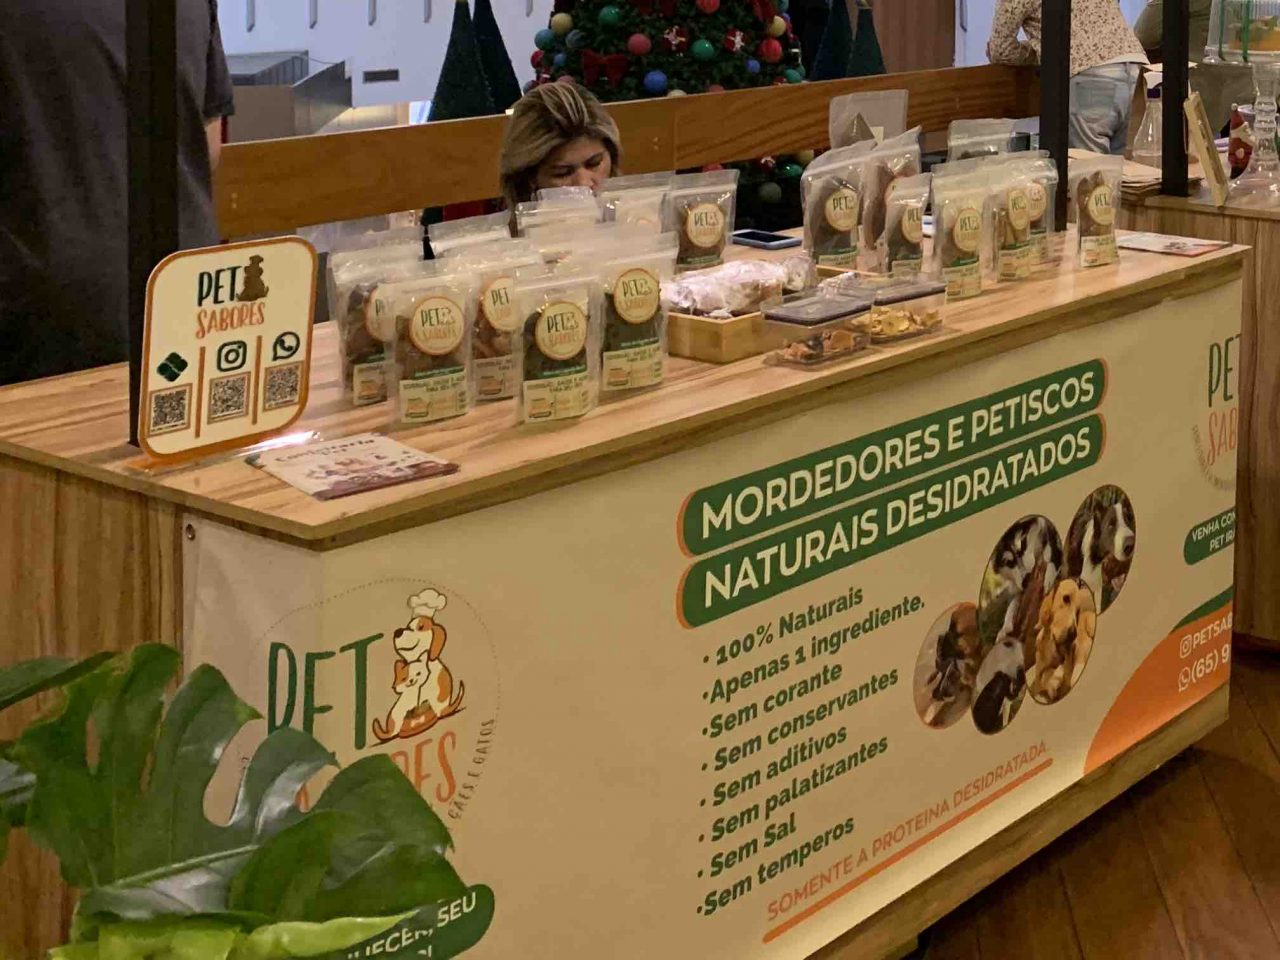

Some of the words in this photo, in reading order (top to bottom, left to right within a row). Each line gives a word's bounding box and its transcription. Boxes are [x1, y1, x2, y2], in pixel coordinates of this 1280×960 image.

[197, 265, 242, 307] PET
[420, 307, 440, 327] PET
[490, 287, 510, 306] PET
[622, 280, 639, 297] PET
[195, 302, 266, 339] SABORES
[547, 312, 565, 333] PET
[702, 424, 940, 539] MORDEDORES
[947, 417, 965, 452] E
[971, 371, 1095, 443] PETISCOS
[704, 508, 879, 608] NATURAIS
[886, 427, 1091, 536] DESIDRATADOS
[1191, 519, 1220, 542] VENHA
[1209, 534, 1225, 552] PET
[710, 653, 790, 704] Apenas
[794, 646, 807, 665] 1
[811, 595, 925, 658] ingrediente.
[715, 622, 774, 666] 100%
[778, 587, 864, 638] Naturais
[1190, 648, 1218, 683] (65)
[1221, 643, 1231, 664] 9
[710, 702, 758, 739] Sem
[763, 663, 842, 713] corante
[714, 735, 762, 771] Sem
[767, 668, 899, 745] conservantes
[711, 804, 759, 842] Sem
[765, 736, 888, 820] palatizantes
[712, 770, 761, 807] Sem
[766, 726, 847, 780] aditivos
[710, 838, 758, 878] Sem
[763, 812, 797, 848] Sal
[767, 854, 853, 922] SOMENTE
[856, 847, 869, 868] A
[872, 799, 950, 858] PROTEINA
[953, 740, 1047, 809] DESIDRATADA
[704, 875, 752, 916] Sem
[757, 817, 854, 885] temperos
[437, 891, 477, 928] SEU
